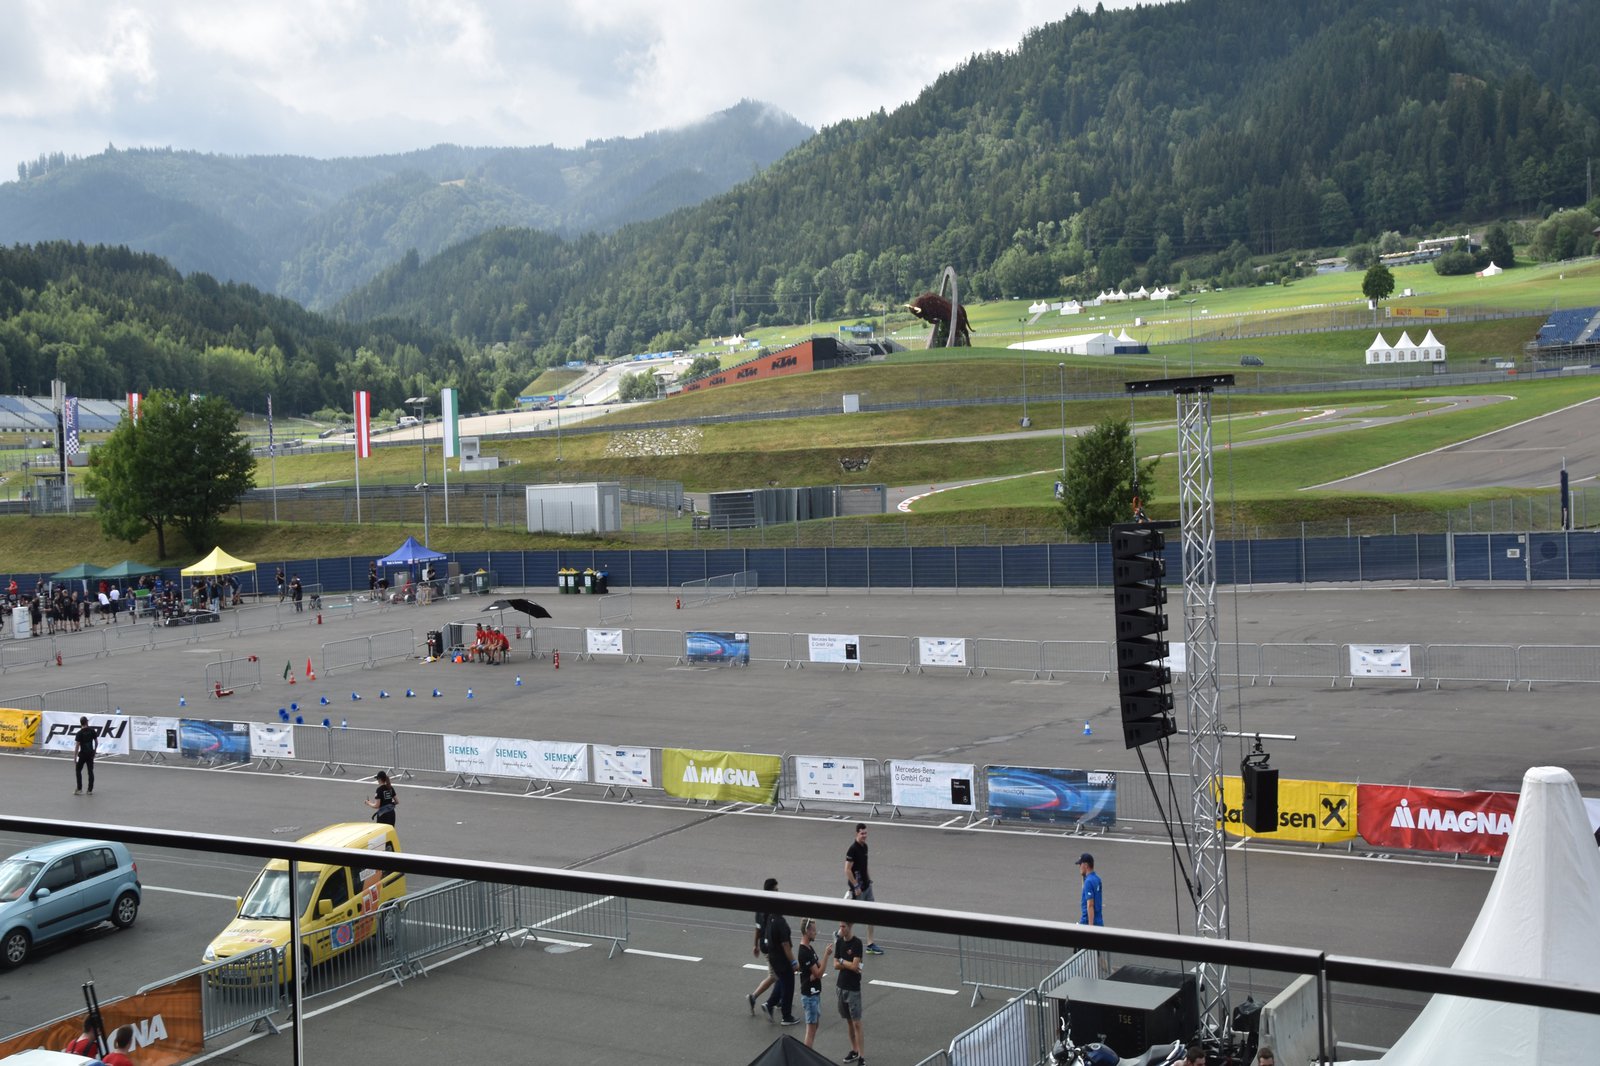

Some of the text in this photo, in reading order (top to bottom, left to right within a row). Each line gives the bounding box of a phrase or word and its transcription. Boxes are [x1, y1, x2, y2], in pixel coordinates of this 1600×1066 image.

[771, 355, 797, 370] KTM
[737, 366, 758, 379] KTM
[0, 733, 18, 743] Bank
[448, 745, 479, 756] SIEMENS
[495, 748, 527, 760] SIEMENS
[544, 752, 577, 763] SIEMENS
[895, 765, 936, 775] Mercedes-Benz
[700, 766, 760, 788] MAGNA
[900, 774, 918, 782] GmbH
[918, 775, 932, 783] Graz
[1417, 807, 1514, 836] MAGNA
[1117, 1013, 1132, 1025] TSE
